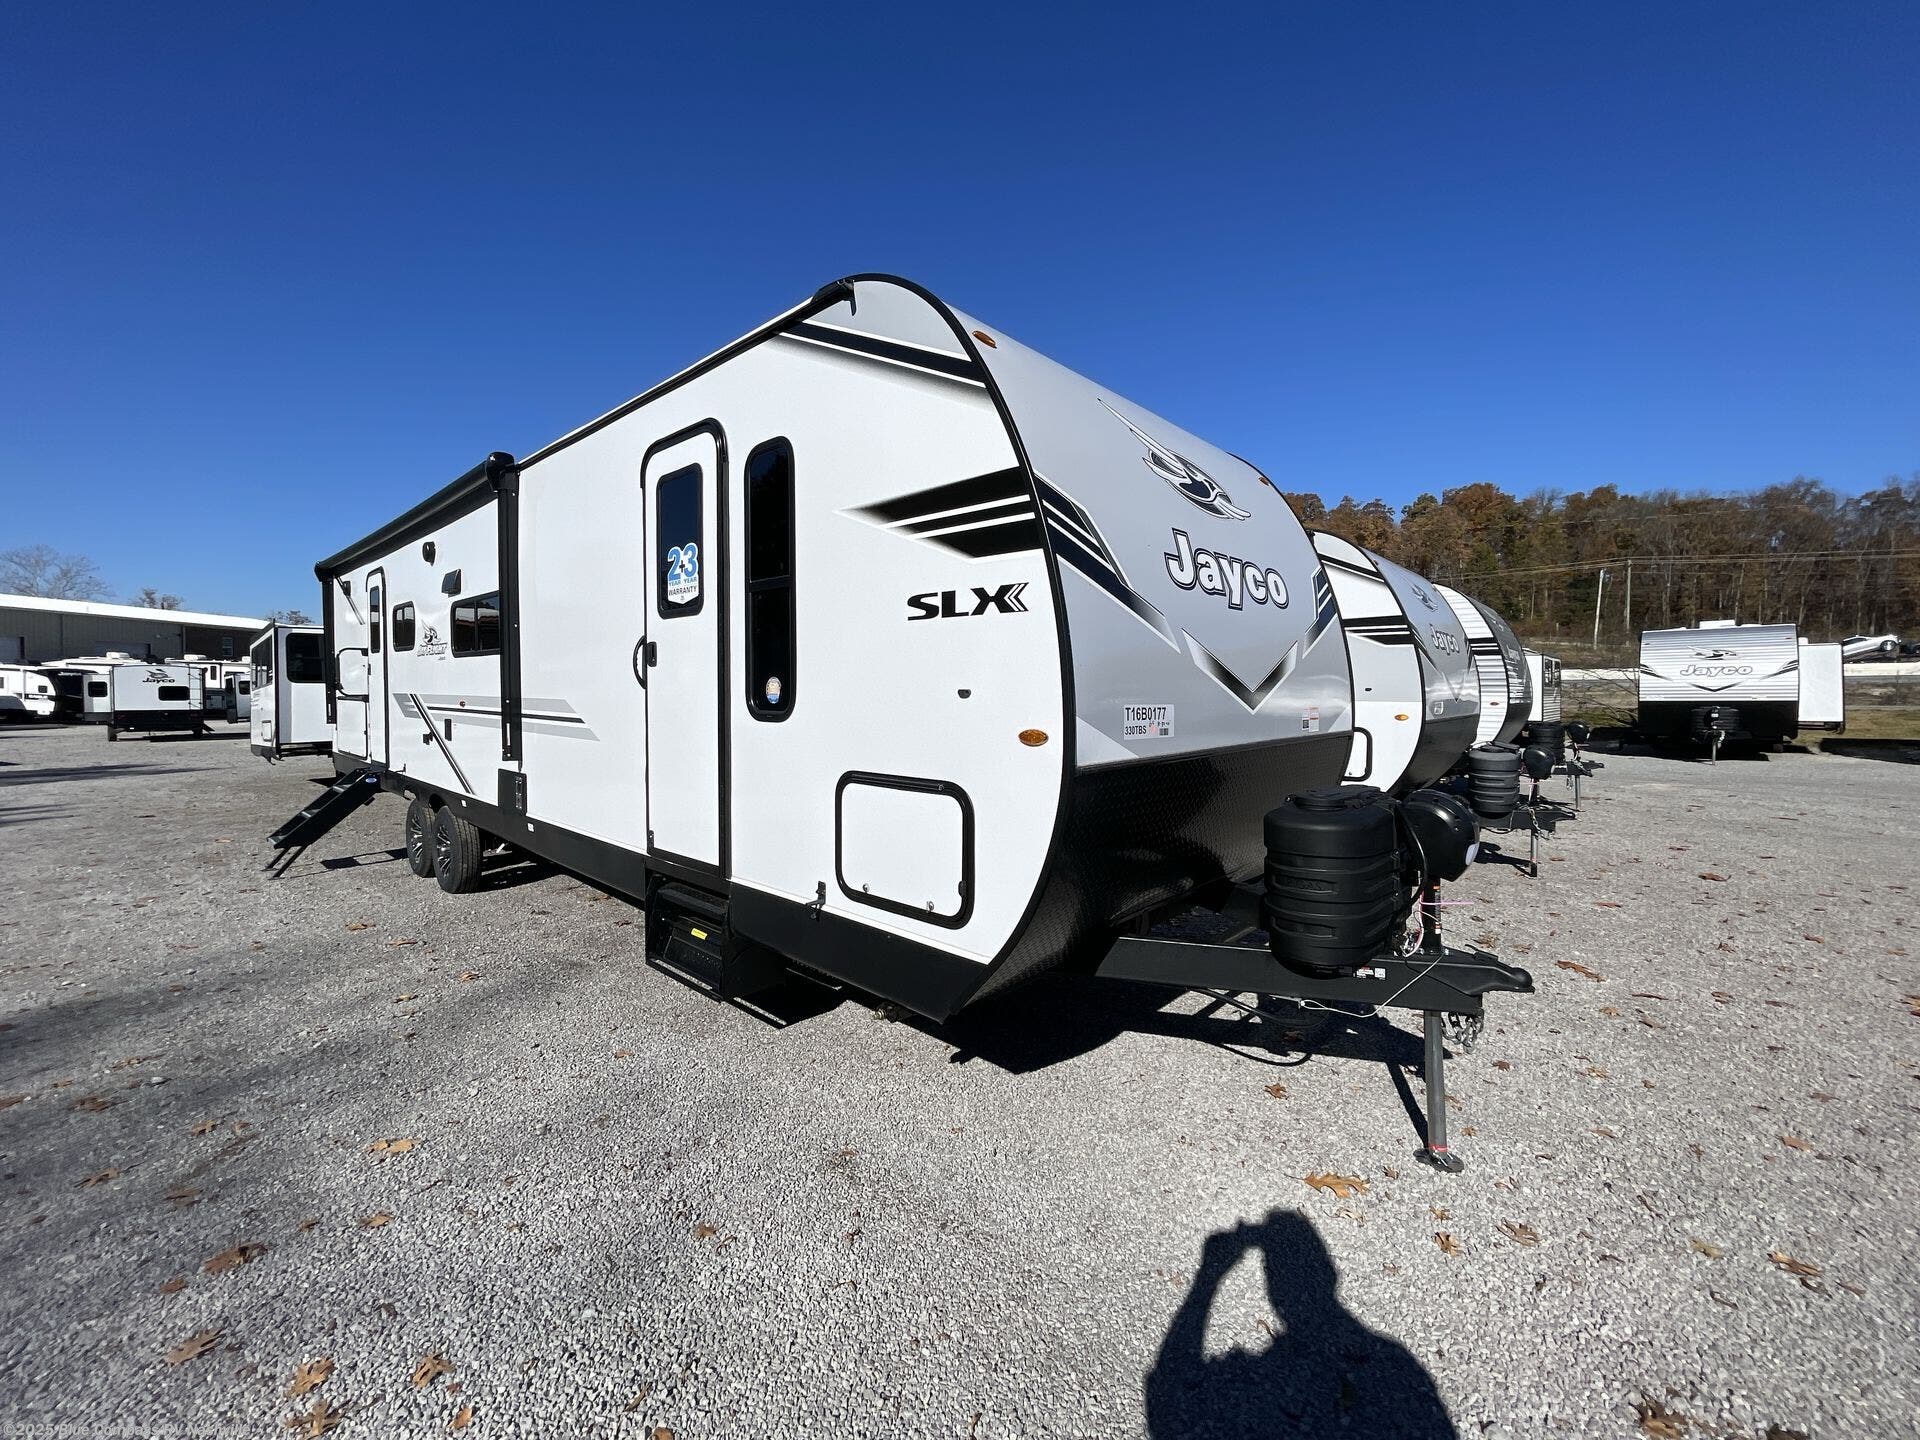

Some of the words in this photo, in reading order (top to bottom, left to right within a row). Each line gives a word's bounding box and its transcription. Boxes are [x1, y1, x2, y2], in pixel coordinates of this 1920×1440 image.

[1164, 527, 1289, 611] Jayco
[669, 586, 697, 596] WARRANTY
[1429, 623, 1460, 655] Jayco
[1680, 665, 1753, 677] Jayco
[1125, 707, 1166, 721] T16B0177
